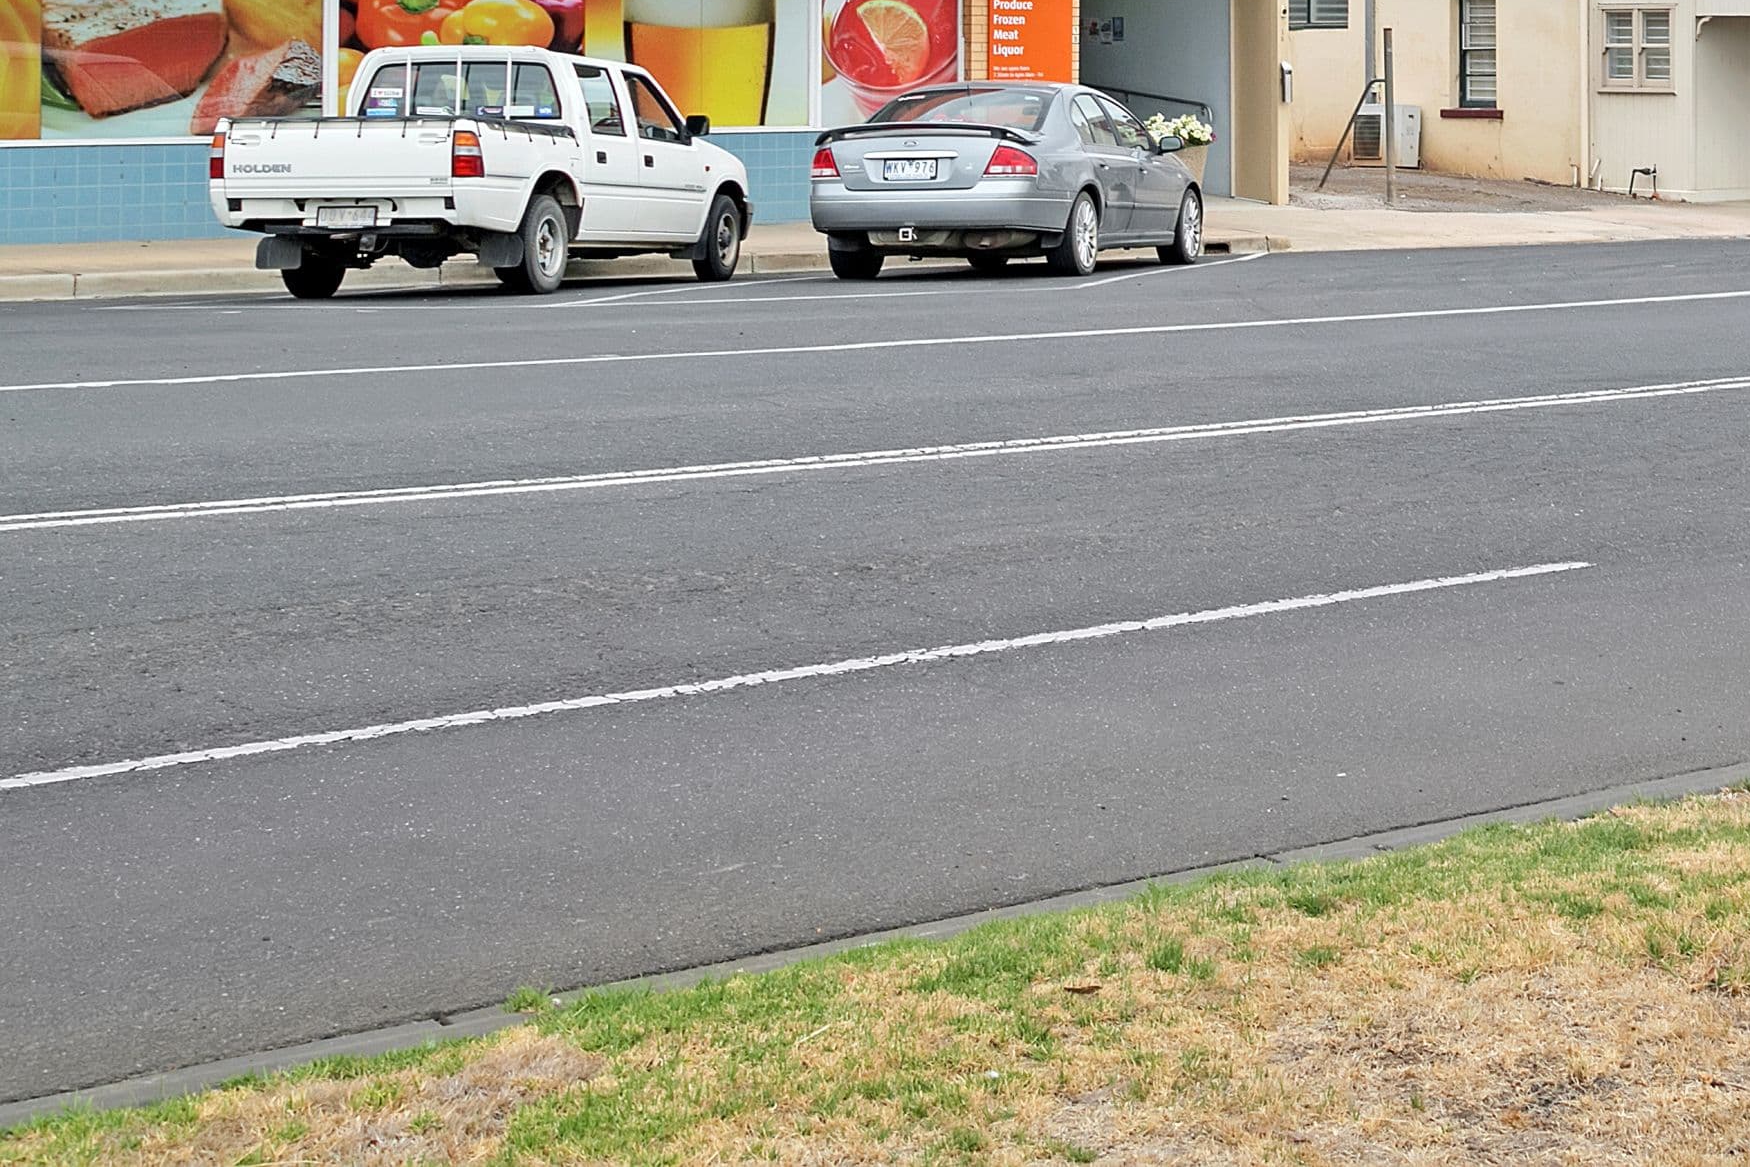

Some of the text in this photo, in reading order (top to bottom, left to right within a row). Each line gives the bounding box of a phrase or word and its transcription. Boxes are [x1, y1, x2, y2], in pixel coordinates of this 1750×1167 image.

[993, 0, 1033, 11] Produce
[993, 14, 1026, 26] Frozen
[993, 29, 1019, 41] Meat
[993, 44, 1025, 58] Liquor
[232, 163, 292, 174] HOLDEN
[885, 160, 935, 174] WKV 976
